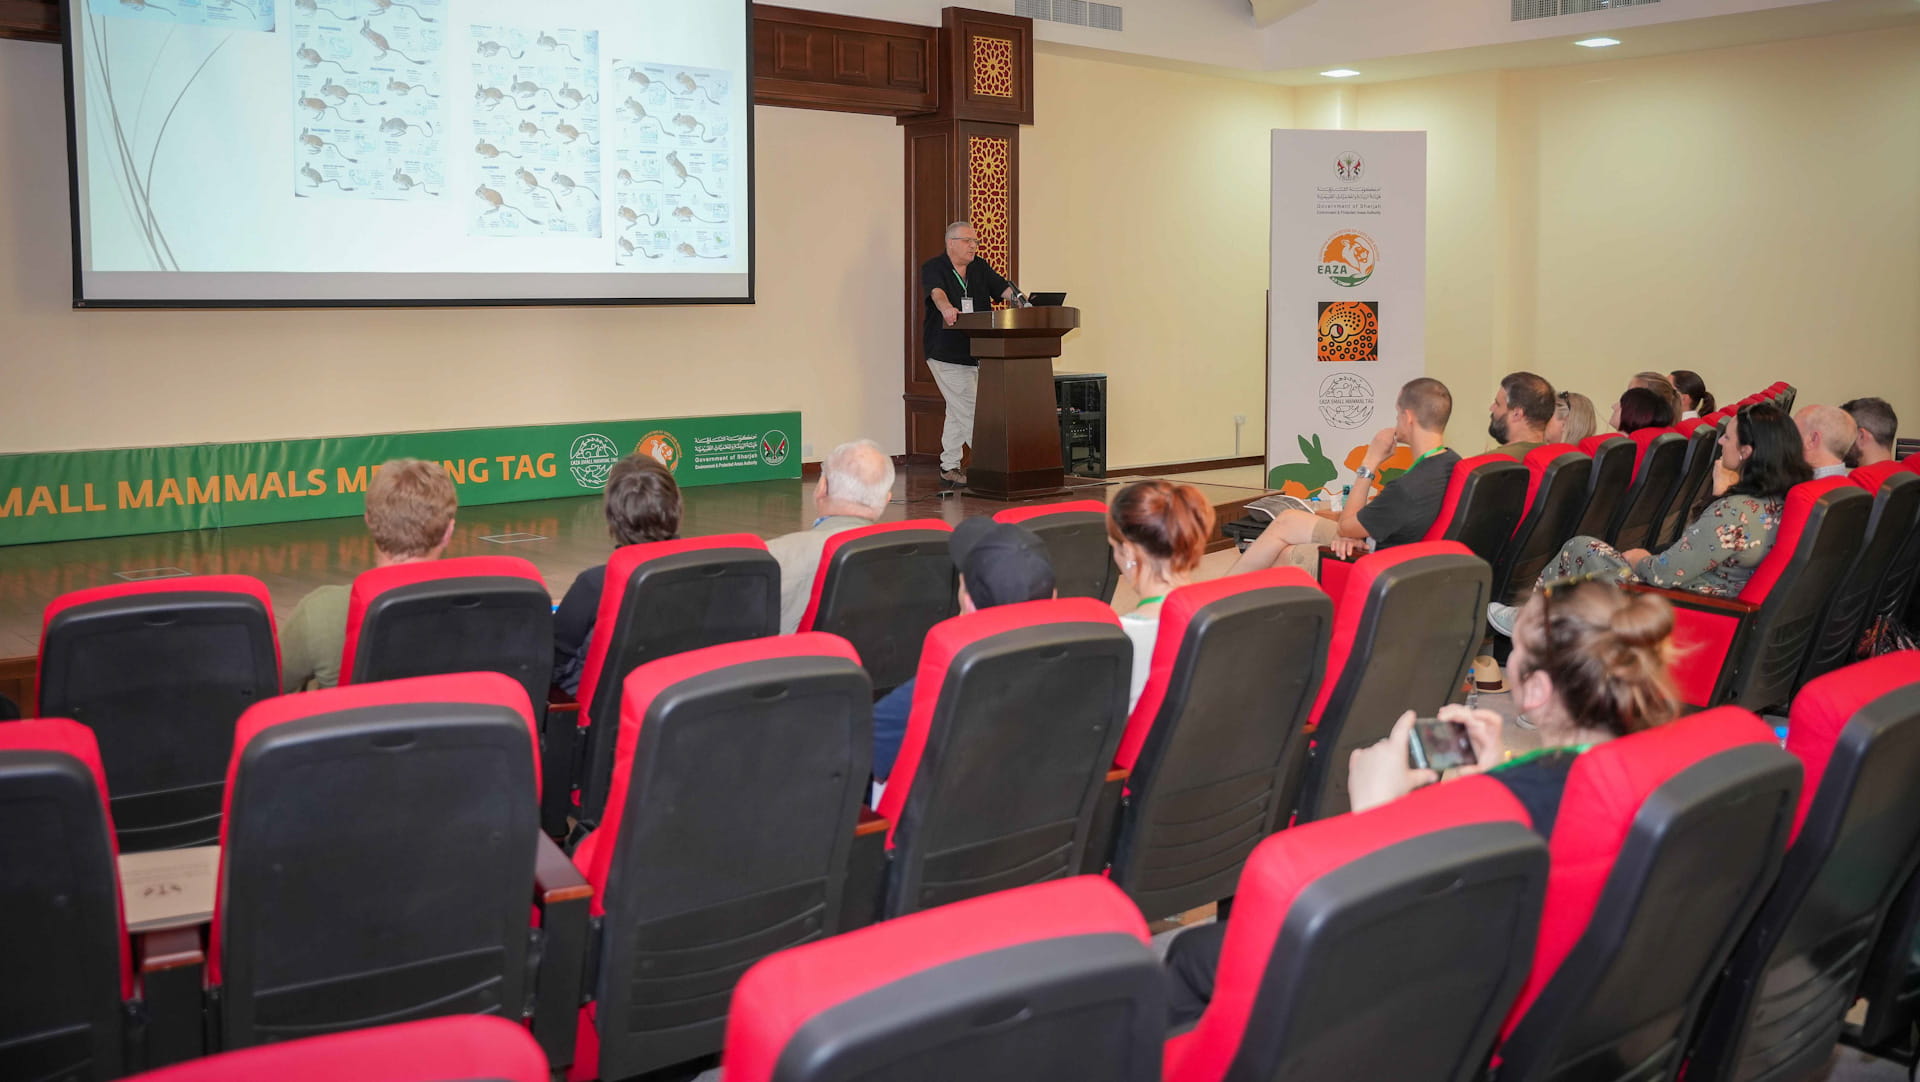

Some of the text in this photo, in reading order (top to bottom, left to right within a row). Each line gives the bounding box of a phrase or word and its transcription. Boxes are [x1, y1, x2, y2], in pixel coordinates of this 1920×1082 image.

[1317, 265, 1348, 275] EAZA
[0, 482, 107, 518] MALL
[117, 468, 328, 509] MAMMALS
[496, 453, 557, 481] TAG
